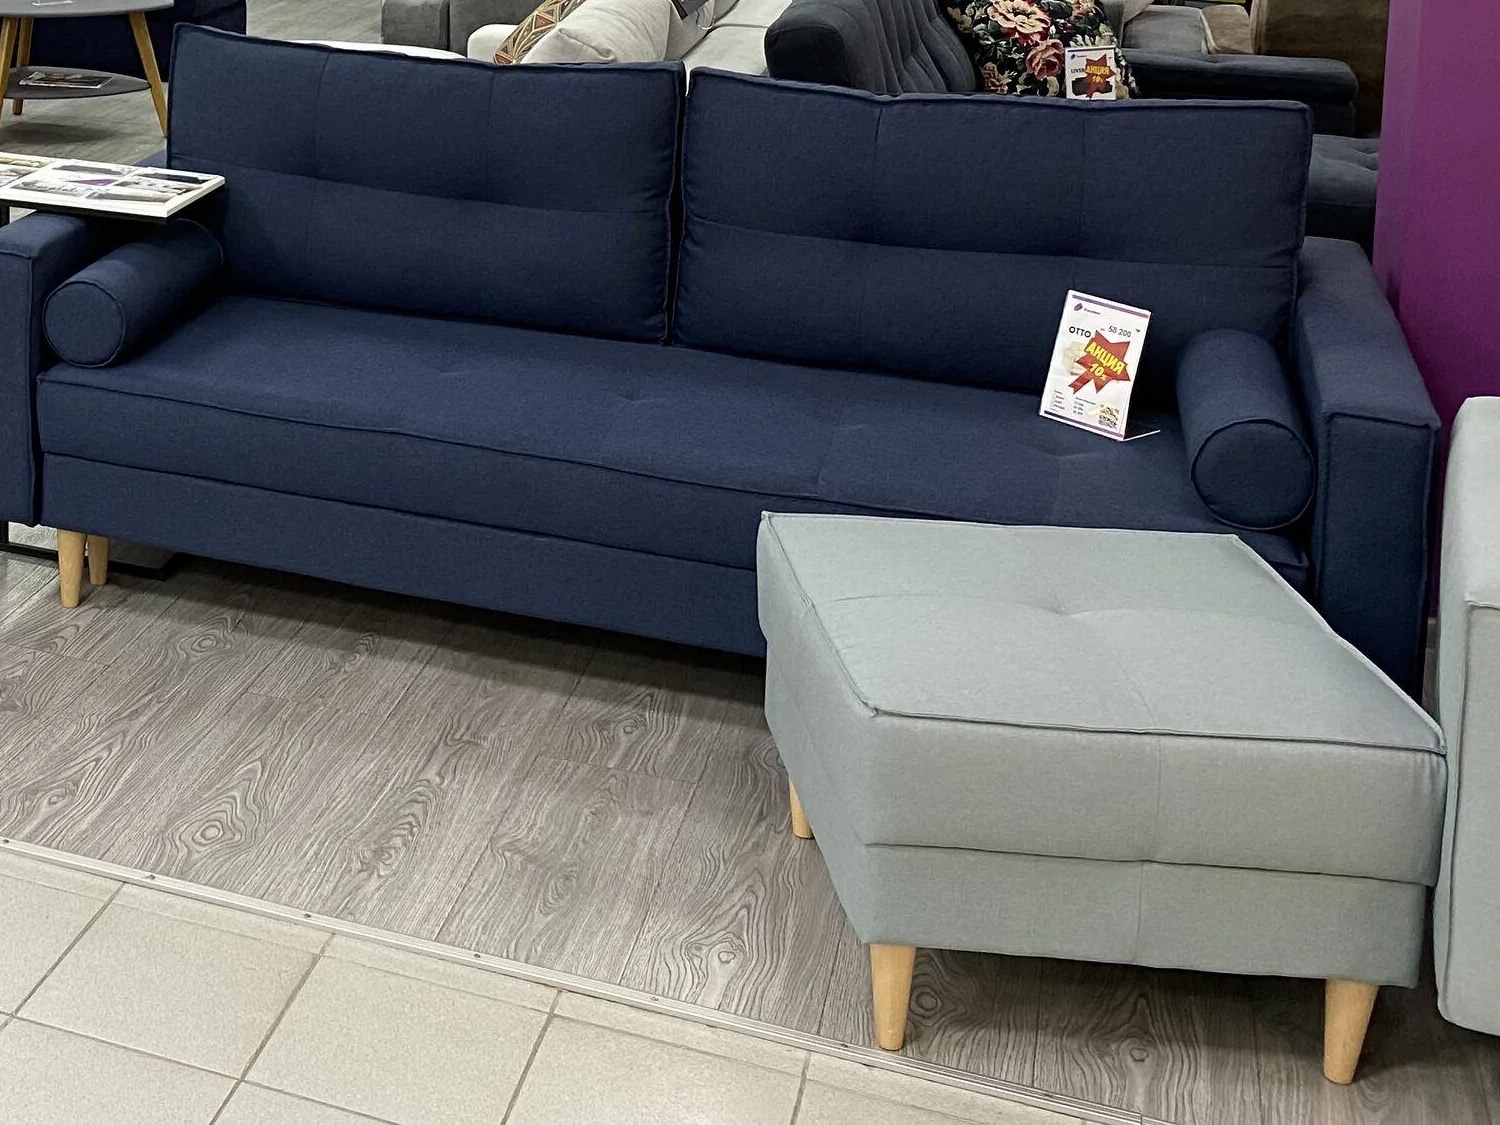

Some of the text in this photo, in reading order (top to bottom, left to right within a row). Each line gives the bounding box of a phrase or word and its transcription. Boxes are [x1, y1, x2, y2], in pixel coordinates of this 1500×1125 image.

[1069, 326, 1092, 338] OTTO
[1119, 328, 1132, 338] 200
[1086, 341, 1125, 375] АКЦИЯ
